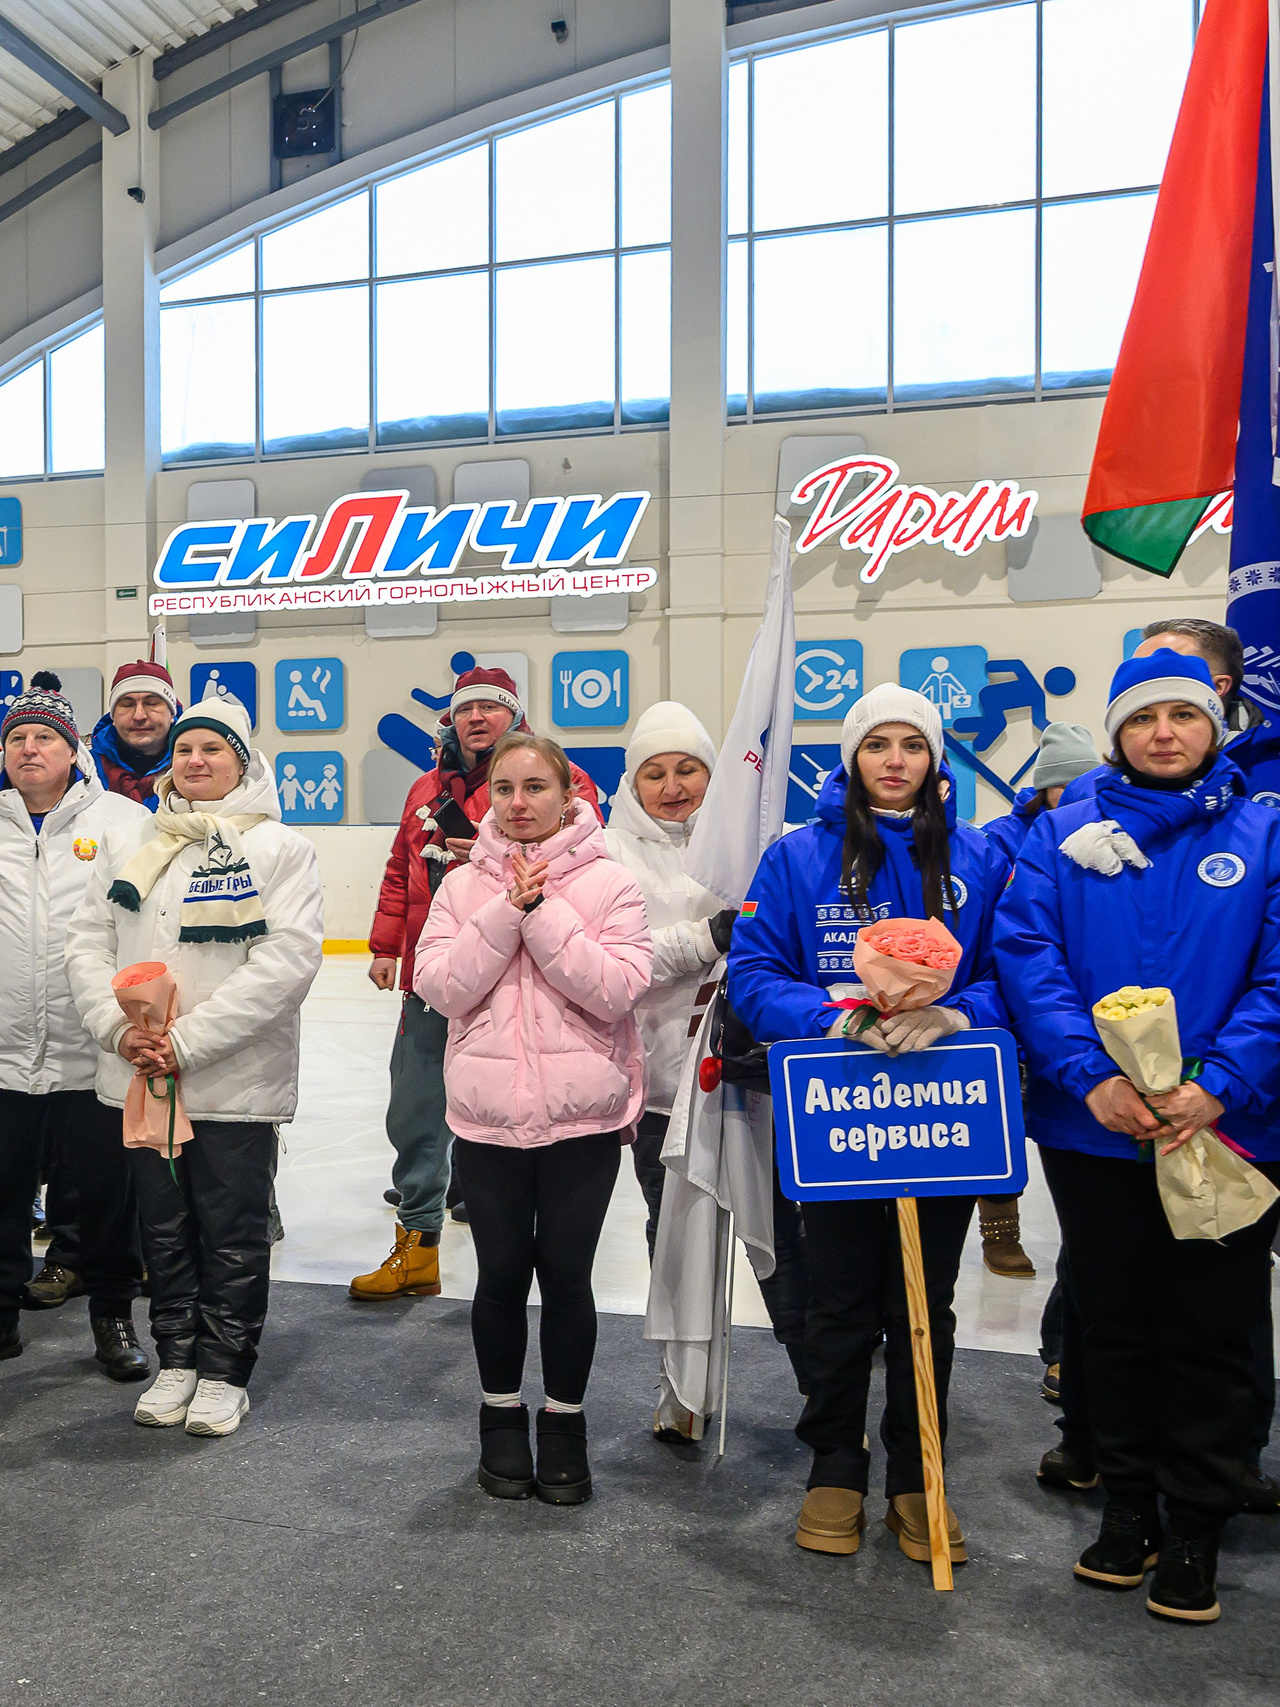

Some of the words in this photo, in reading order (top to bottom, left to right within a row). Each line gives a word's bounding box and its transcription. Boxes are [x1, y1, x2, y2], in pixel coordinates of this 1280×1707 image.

[153, 583, 371, 611] РЕСПУБЛИКАНСКИЙ
[378, 574, 565, 600] ГОРНОЛЫЖНЫЙ
[572, 573, 651, 594] ЦЕНТР
[825, 669, 858, 690] 24
[188, 879, 225, 894] БЕЛЫЕ
[823, 932, 857, 945] АКАД
[804, 1072, 988, 1114] Академия
[828, 1121, 970, 1162] сервиса
